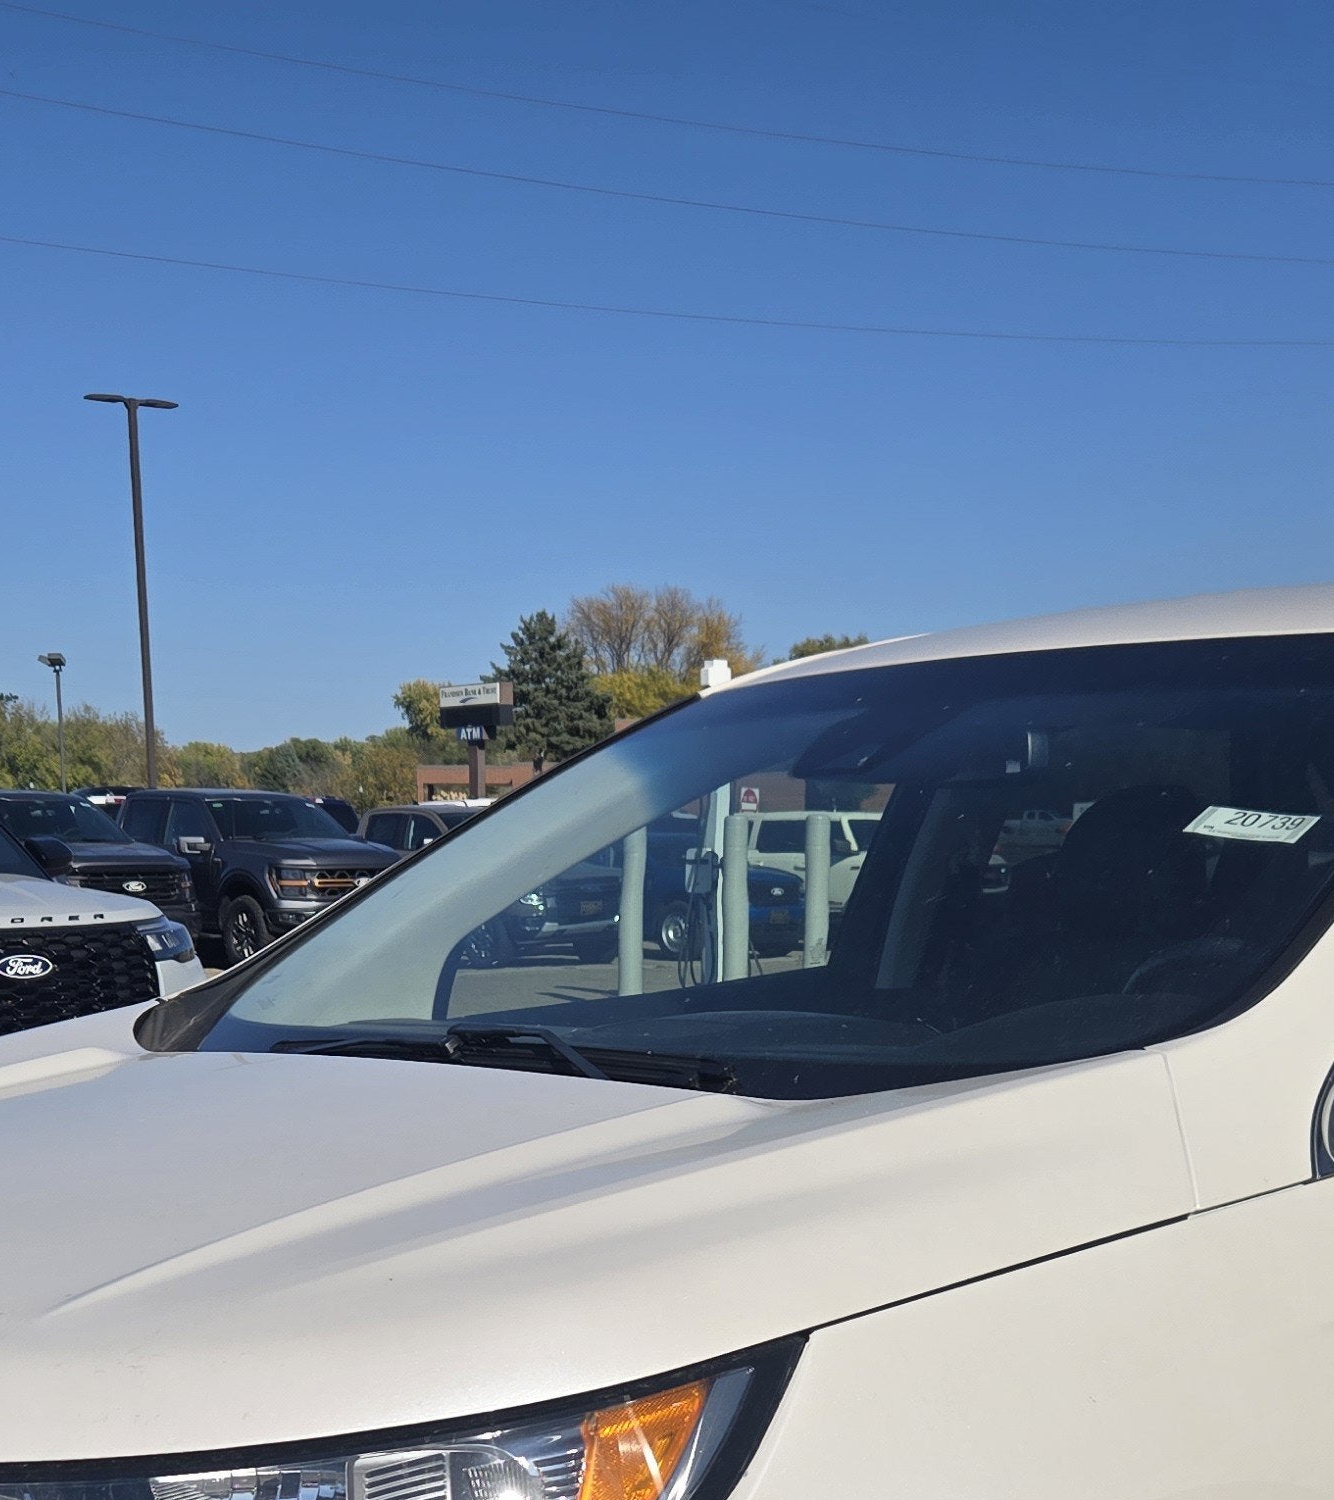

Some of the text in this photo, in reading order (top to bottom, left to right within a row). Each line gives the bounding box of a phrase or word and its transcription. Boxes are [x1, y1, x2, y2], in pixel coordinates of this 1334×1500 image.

[460, 726, 481, 740] ATM
[1225, 811, 1306, 831] 20739
[5, 957, 44, 976] Ford
